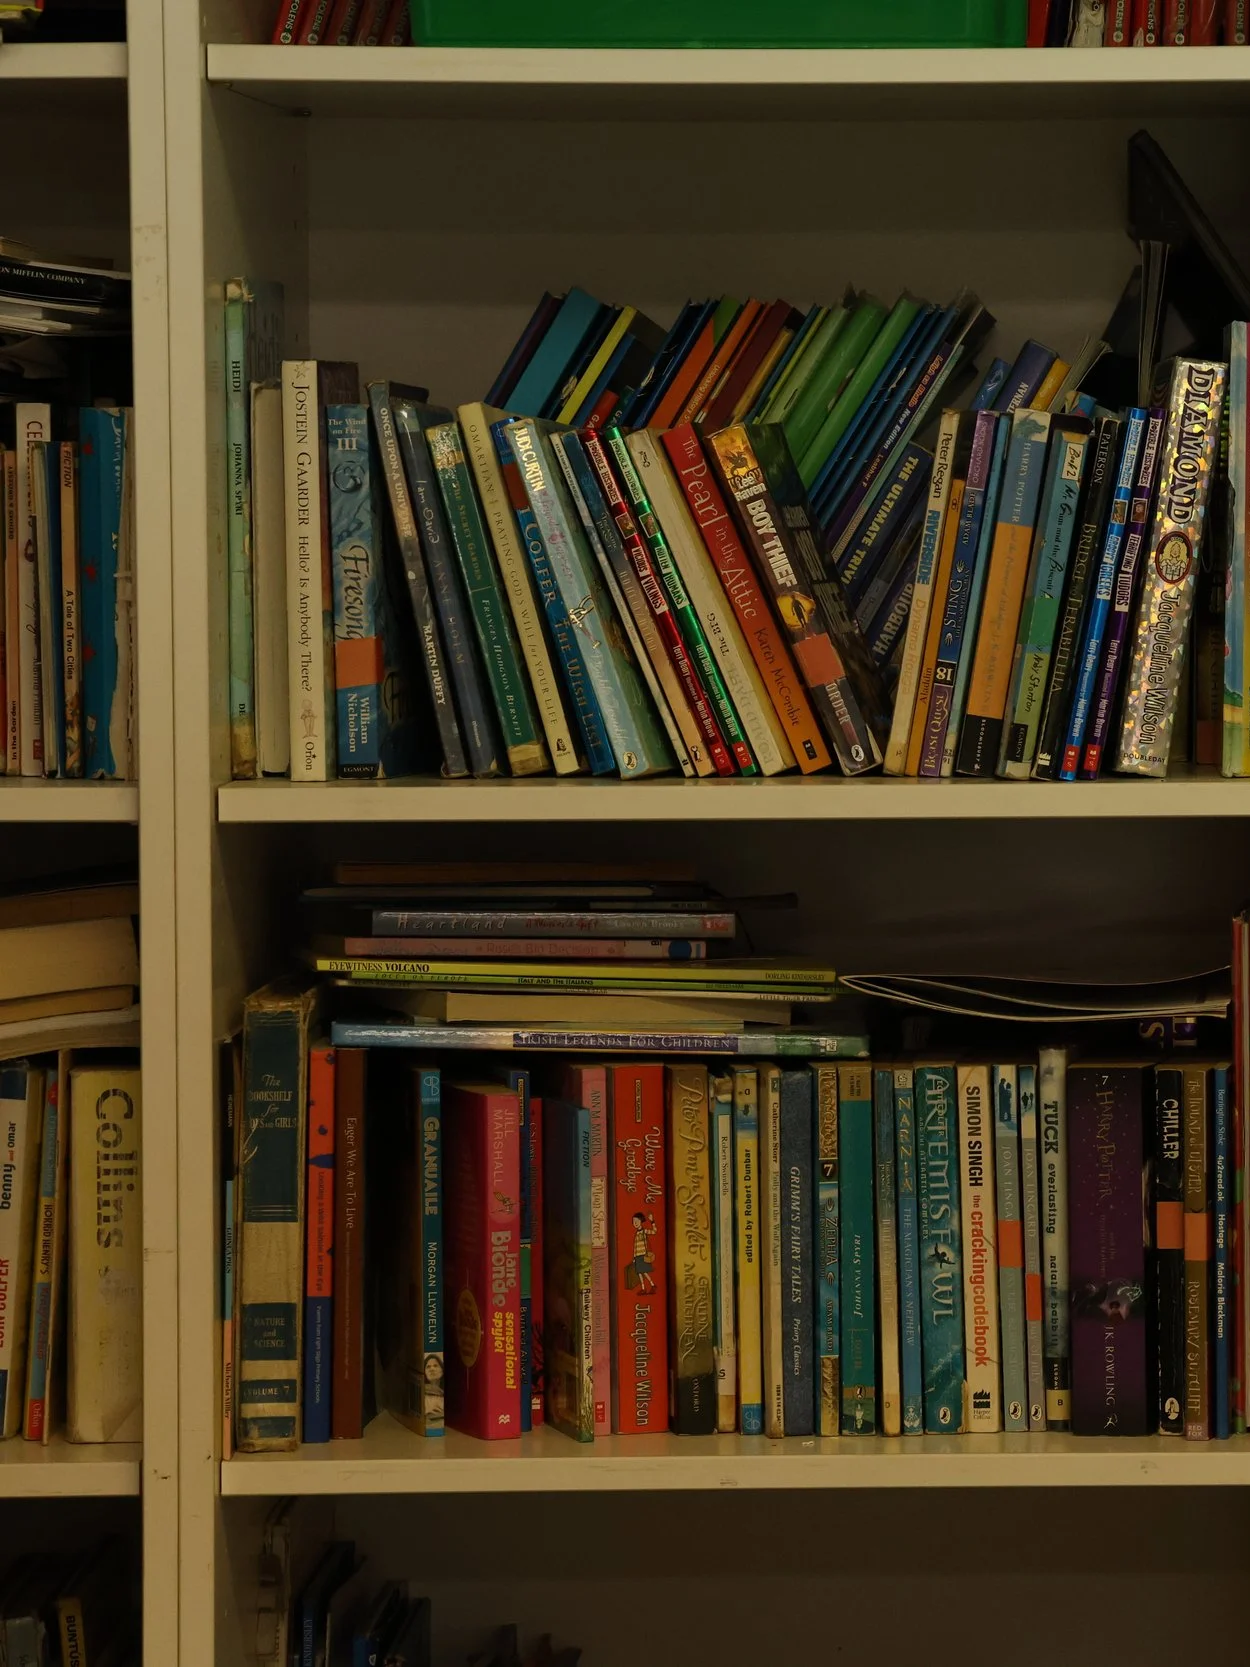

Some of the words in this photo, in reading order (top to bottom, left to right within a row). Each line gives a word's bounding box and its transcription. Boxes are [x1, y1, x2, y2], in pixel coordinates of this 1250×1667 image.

[12, 268, 44, 279] MIFFLIN
[47, 273, 86, 284] COMPANY
[231, 360, 240, 393] HEIDI
[291, 382, 310, 444] JOSTEIN
[232, 442, 243, 486] JOHANNA
[680, 436, 698, 460] The
[937, 432, 952, 461] Peter
[1092, 432, 1112, 484] PATERSON
[1167, 367, 1215, 525] DIAMOND
[63, 449, 71, 488] FICTION
[296, 451, 311, 526] GAARDER
[931, 462, 948, 499] Regan
[234, 490, 243, 516] SPYRI
[681, 462, 728, 529] Pearl
[297, 535, 310, 573] Hello?
[714, 527, 728, 540] in
[715, 542, 737, 565] the
[745, 499, 772, 536] BOY
[761, 535, 797, 588] THIEF
[916, 509, 941, 585] RIVERSIDE
[299, 577, 310, 588] Is
[339, 545, 370, 641] Firesong
[631, 547, 646, 573] VICIOUS
[641, 579, 664, 610] VIKINGS
[719, 564, 758, 620] Attic
[1096, 565, 1116, 597] GREEKS
[1115, 573, 1134, 606] TUDORS
[65, 599, 73, 619] Tale
[65, 621, 73, 630] of
[297, 592, 312, 647] Anybody
[66, 633, 74, 652] Two
[422, 624, 439, 668] MARTIN
[1147, 588, 1181, 685] Jacqueline
[66, 655, 74, 680] Cities
[300, 652, 314, 693] There?
[752, 627, 775, 665] Karen
[769, 668, 802, 727] McCombie
[1030, 653, 1045, 675] Andy
[428, 669, 445, 706] DUFFY
[1024, 675, 1041, 713] Stanton
[346, 692, 360, 753] Nicholson
[358, 697, 371, 744] William
[1139, 686, 1168, 745] Wilson
[303, 741, 316, 771] Orion
[974, 719, 987, 763] BLOOMSBURY
[1122, 752, 1166, 764] DOUBLEDAY
[328, 961, 384, 972] EYEWITNESS
[385, 962, 430, 973] VOLCANO
[520, 1034, 559, 1046] IRISH
[562, 1035, 625, 1048] LEGENDS
[628, 1036, 658, 1048] FOR
[660, 1036, 732, 1050] CHILDREN
[344, 1117, 356, 1146] Eager
[965, 1086, 981, 1137] SIMON
[1043, 1101, 1058, 1154] TUCK
[1160, 1098, 1179, 1160] CHILLER
[95, 1088, 137, 1249] Collins
[346, 1149, 356, 1167] We
[423, 1116, 440, 1216] GRANUAILE
[618, 1137, 642, 1193] Goodbye
[643, 1126, 662, 1173] Wave
[967, 1139, 983, 1187] SINGH
[345, 1169, 356, 1188] Are
[345, 1192, 356, 1205] To
[645, 1176, 662, 1203] Me
[790, 1166, 801, 1223] GRIMM'S
[1045, 1163, 1058, 1234] everlasting
[345, 1207, 356, 1229] Live
[972, 1195, 981, 1208] the
[790, 1225, 801, 1263] FAIRY
[1215, 1213, 1227, 1249] Hostage
[426, 1241, 438, 1288] MORGAN
[491, 1230, 509, 1307] Blonde
[791, 1265, 802, 1304] TALES
[1216, 1262, 1226, 1293] Malorie
[581, 1288, 591, 1322] Railway
[969, 1211, 990, 1368] crackingcodebook
[427, 1291, 439, 1344] LLYWELYN
[1216, 1295, 1226, 1339] Blackman
[504, 1311, 516, 1389] sensational
[583, 1324, 591, 1360] Children
[633, 1303, 651, 1378] Jacqueline
[1104, 1347, 1116, 1407] ROWLING
[31, 1402, 41, 1428] Orion
[635, 1379, 651, 1426] Wilson
